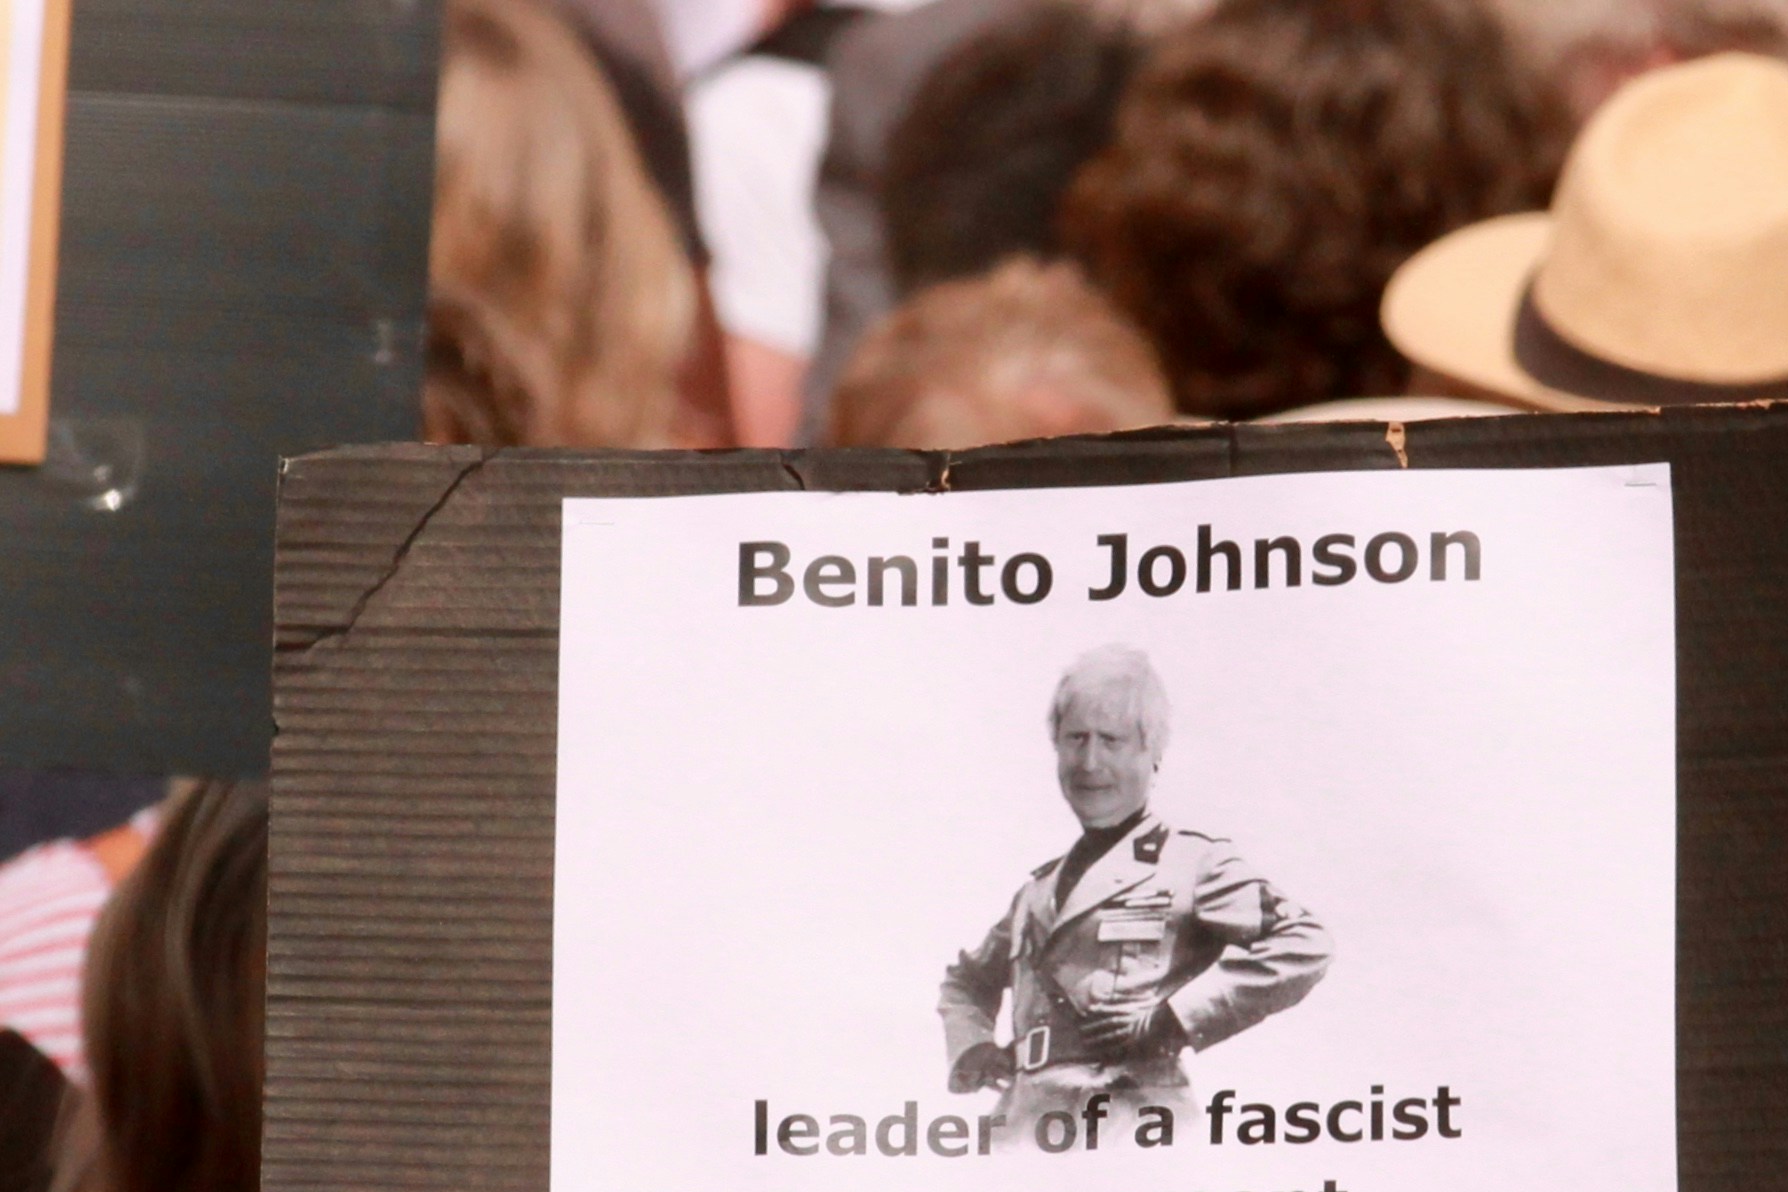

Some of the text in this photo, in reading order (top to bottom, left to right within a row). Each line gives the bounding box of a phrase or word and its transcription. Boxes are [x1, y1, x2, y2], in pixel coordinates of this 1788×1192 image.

[737, 523, 1483, 607] Benito Johnson
[752, 1085, 1463, 1158] leader of a fascist
